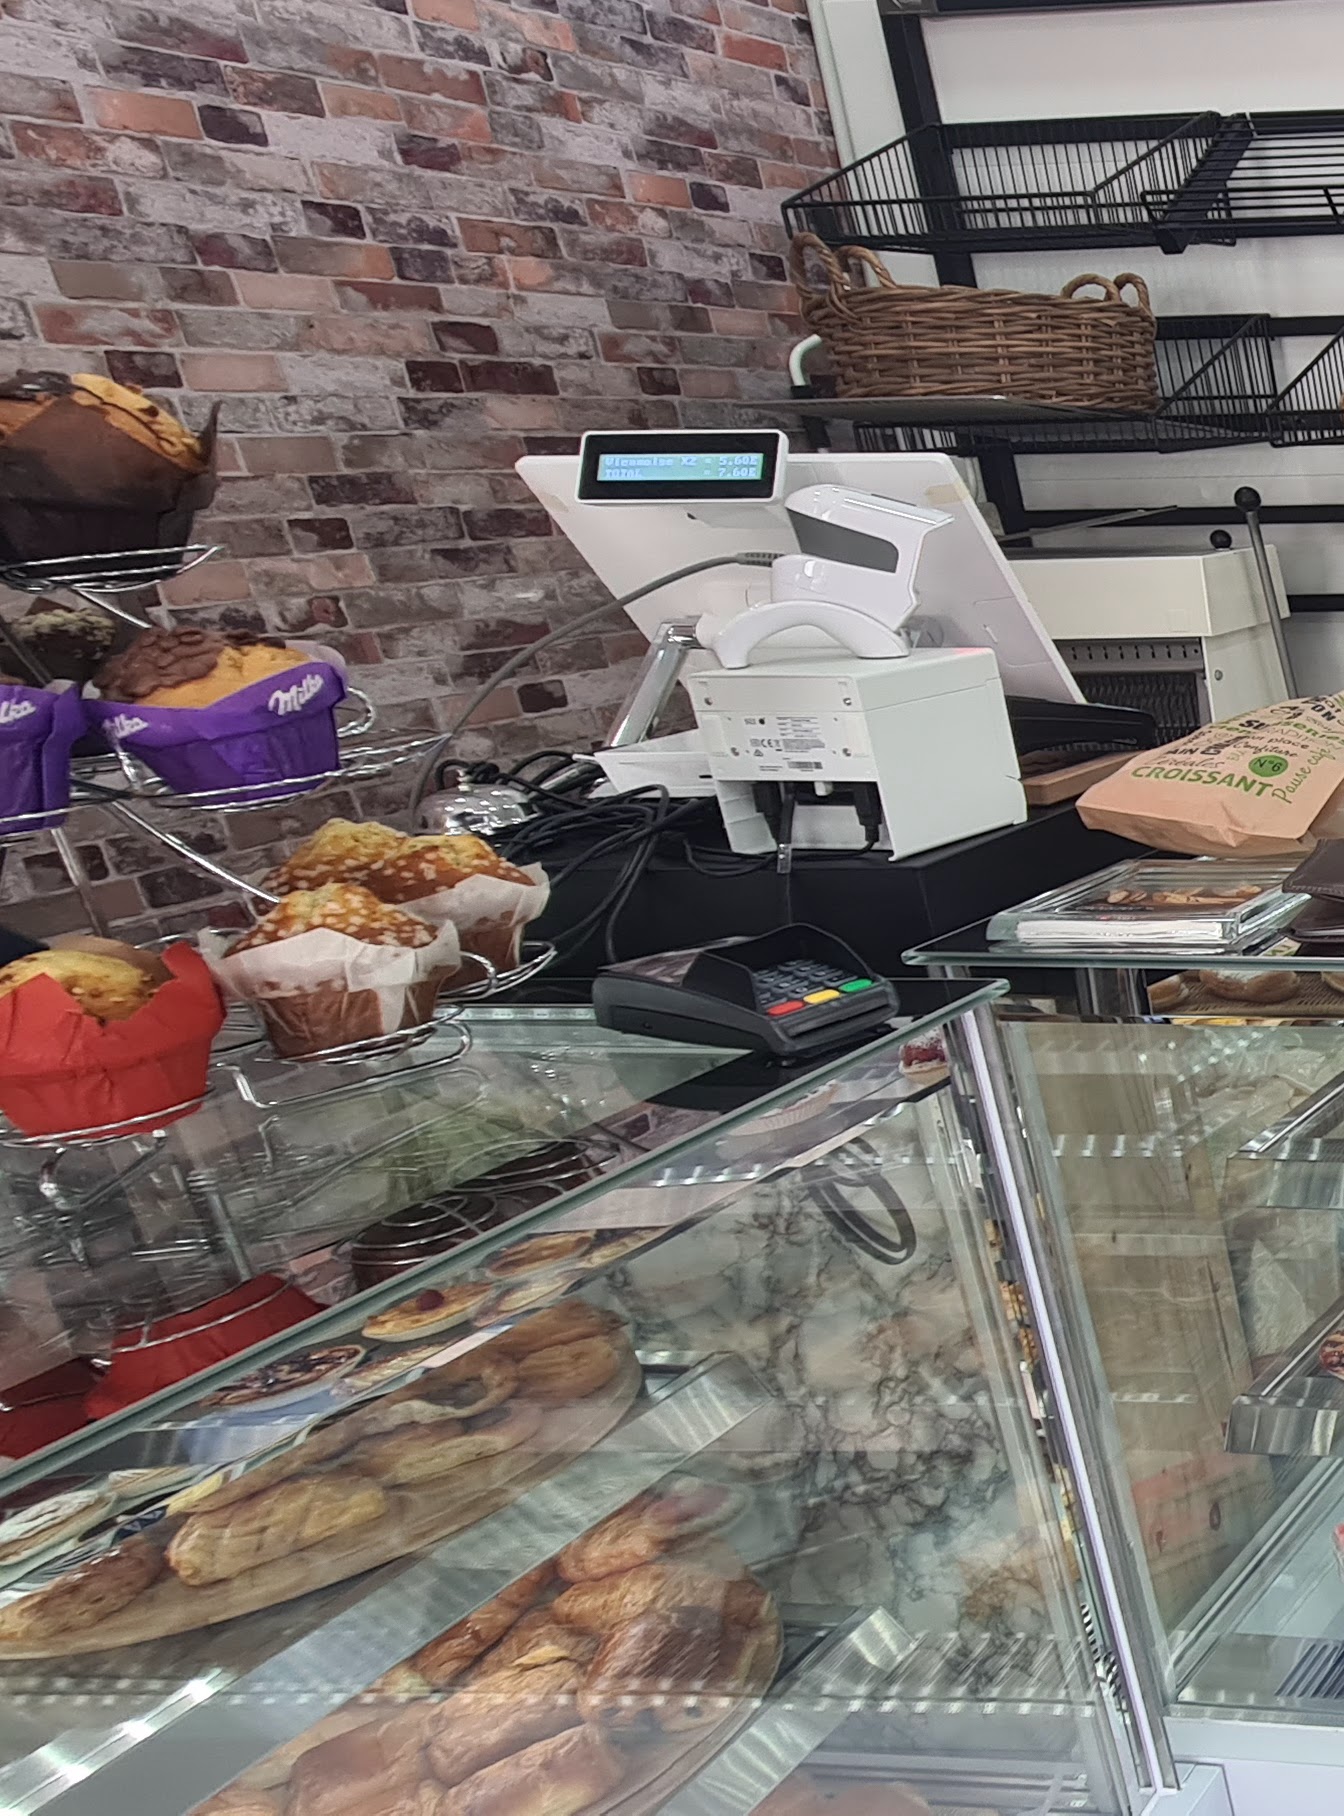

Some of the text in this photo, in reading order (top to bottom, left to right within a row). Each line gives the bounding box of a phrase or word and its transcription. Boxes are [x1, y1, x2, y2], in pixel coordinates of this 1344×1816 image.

[605, 469, 643, 478] TOTAL
[1131, 765, 1274, 797] CROISSANT
[1271, 767, 1312, 804] Pause
